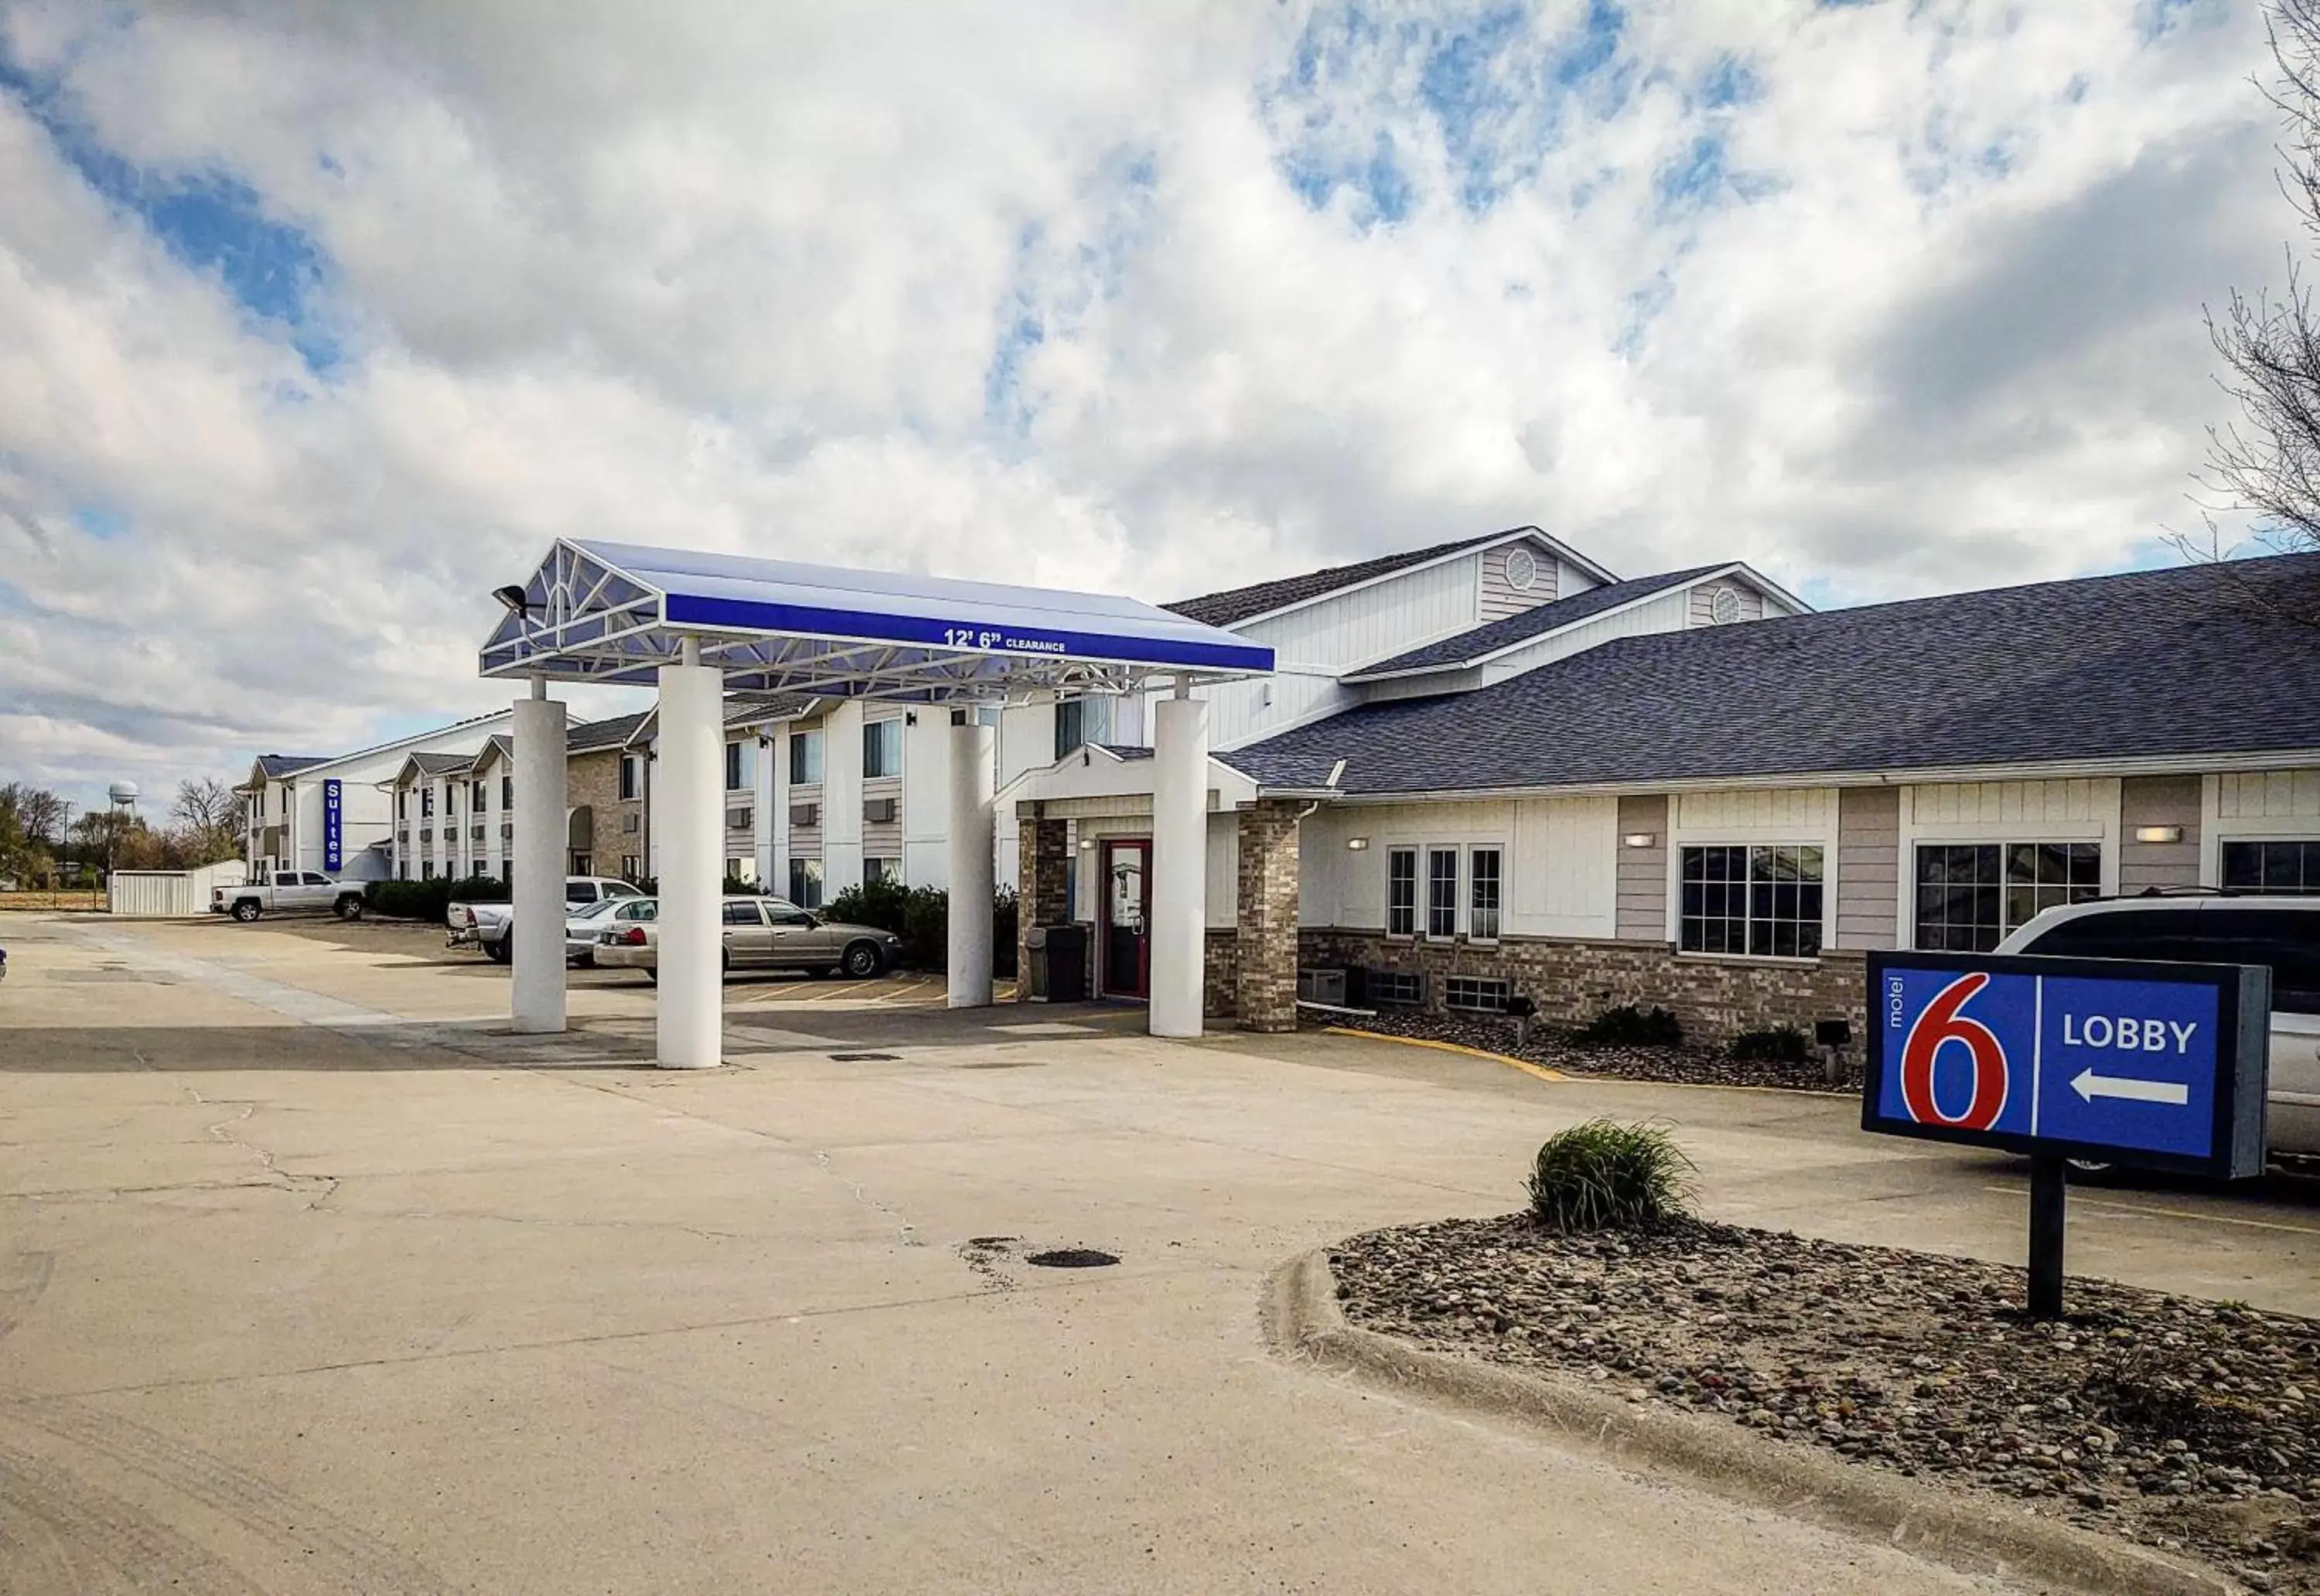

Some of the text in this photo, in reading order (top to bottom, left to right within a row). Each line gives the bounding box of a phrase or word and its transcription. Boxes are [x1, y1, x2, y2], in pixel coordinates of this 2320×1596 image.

[1005, 638, 1065, 653] CLEARANCE
[327, 784, 339, 863] Suites
[1888, 972, 2008, 1130] motel 6
[2063, 1014, 2197, 1054] LOBBY
